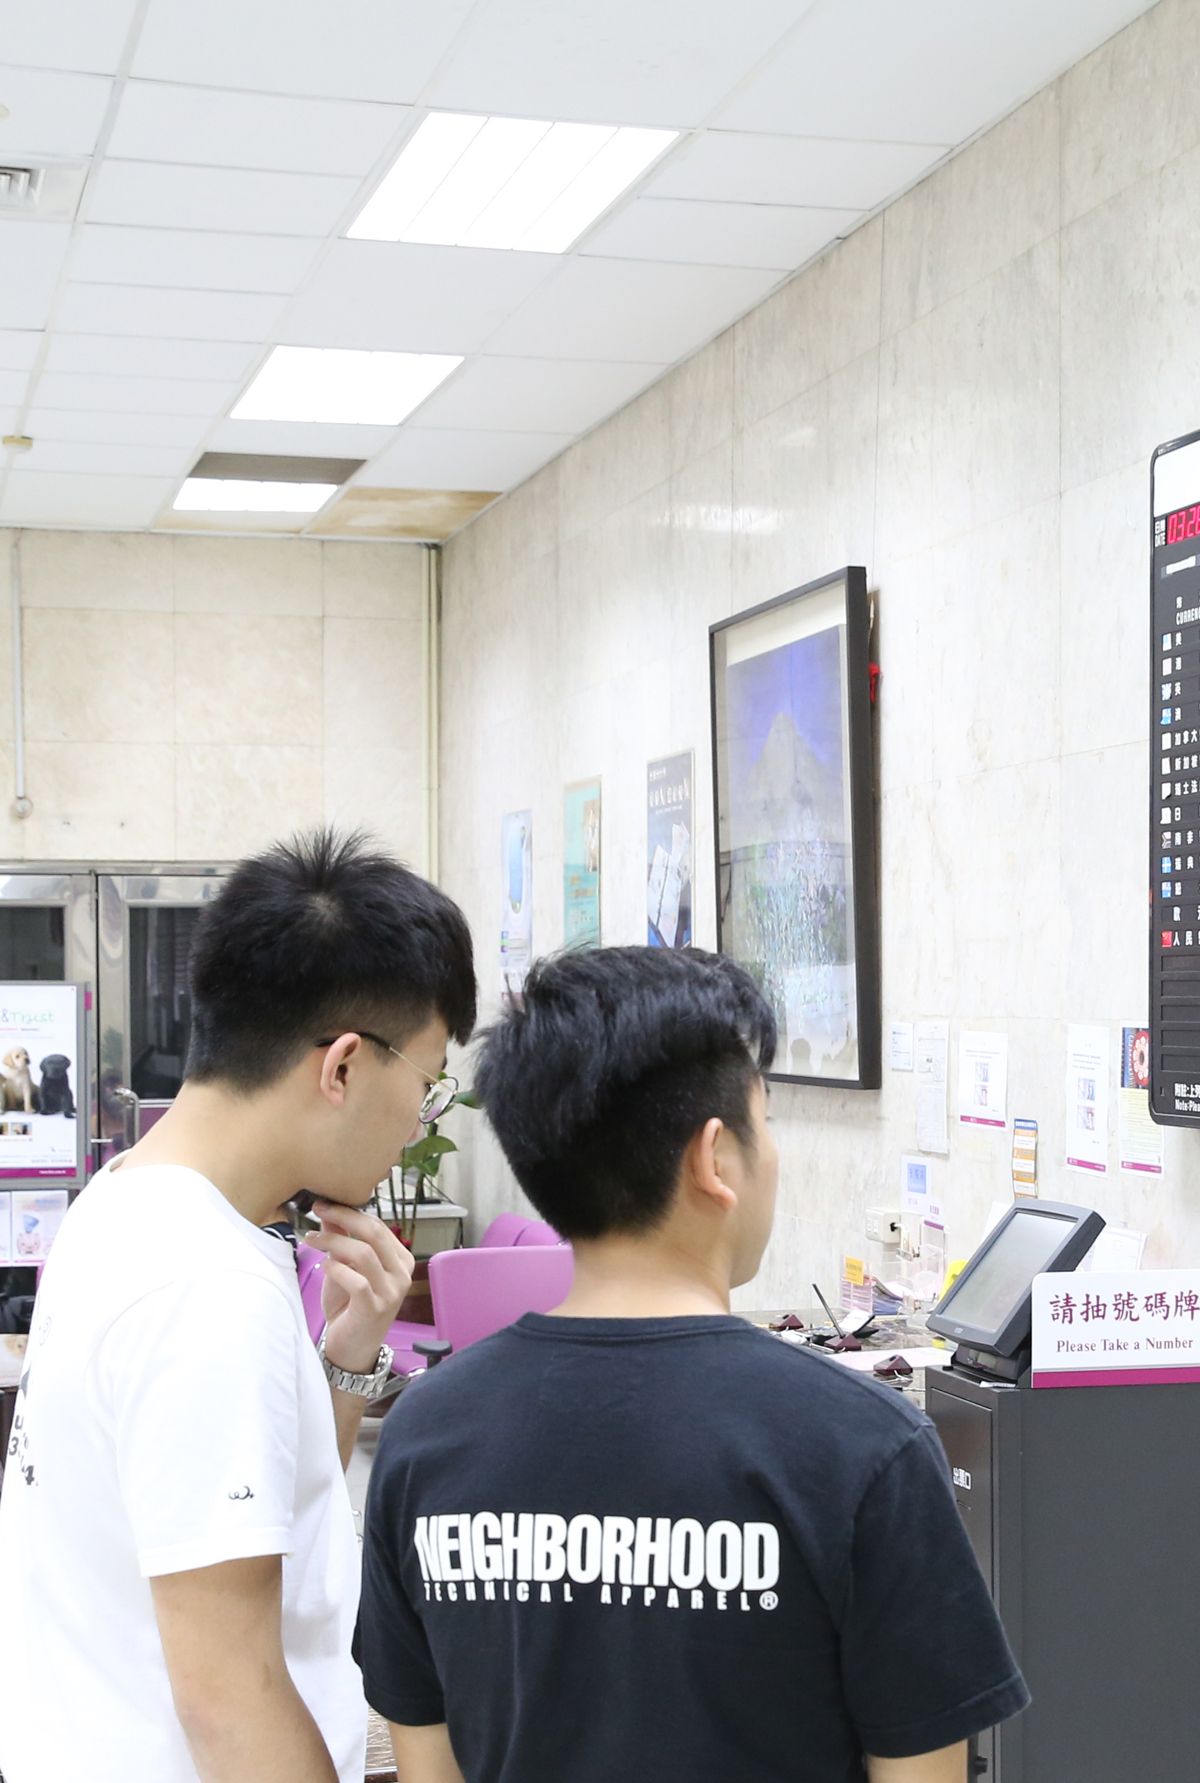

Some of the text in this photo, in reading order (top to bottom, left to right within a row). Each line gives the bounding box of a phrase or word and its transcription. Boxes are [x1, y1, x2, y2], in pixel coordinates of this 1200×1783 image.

[1050, 1290, 1200, 1325] 請抽號碼牌
[1057, 1337, 1194, 1353] Please Take a Number
[414, 1511, 780, 1591] NEIGHBORHOOD
[424, 1582, 572, 1602] TECHNICAL
